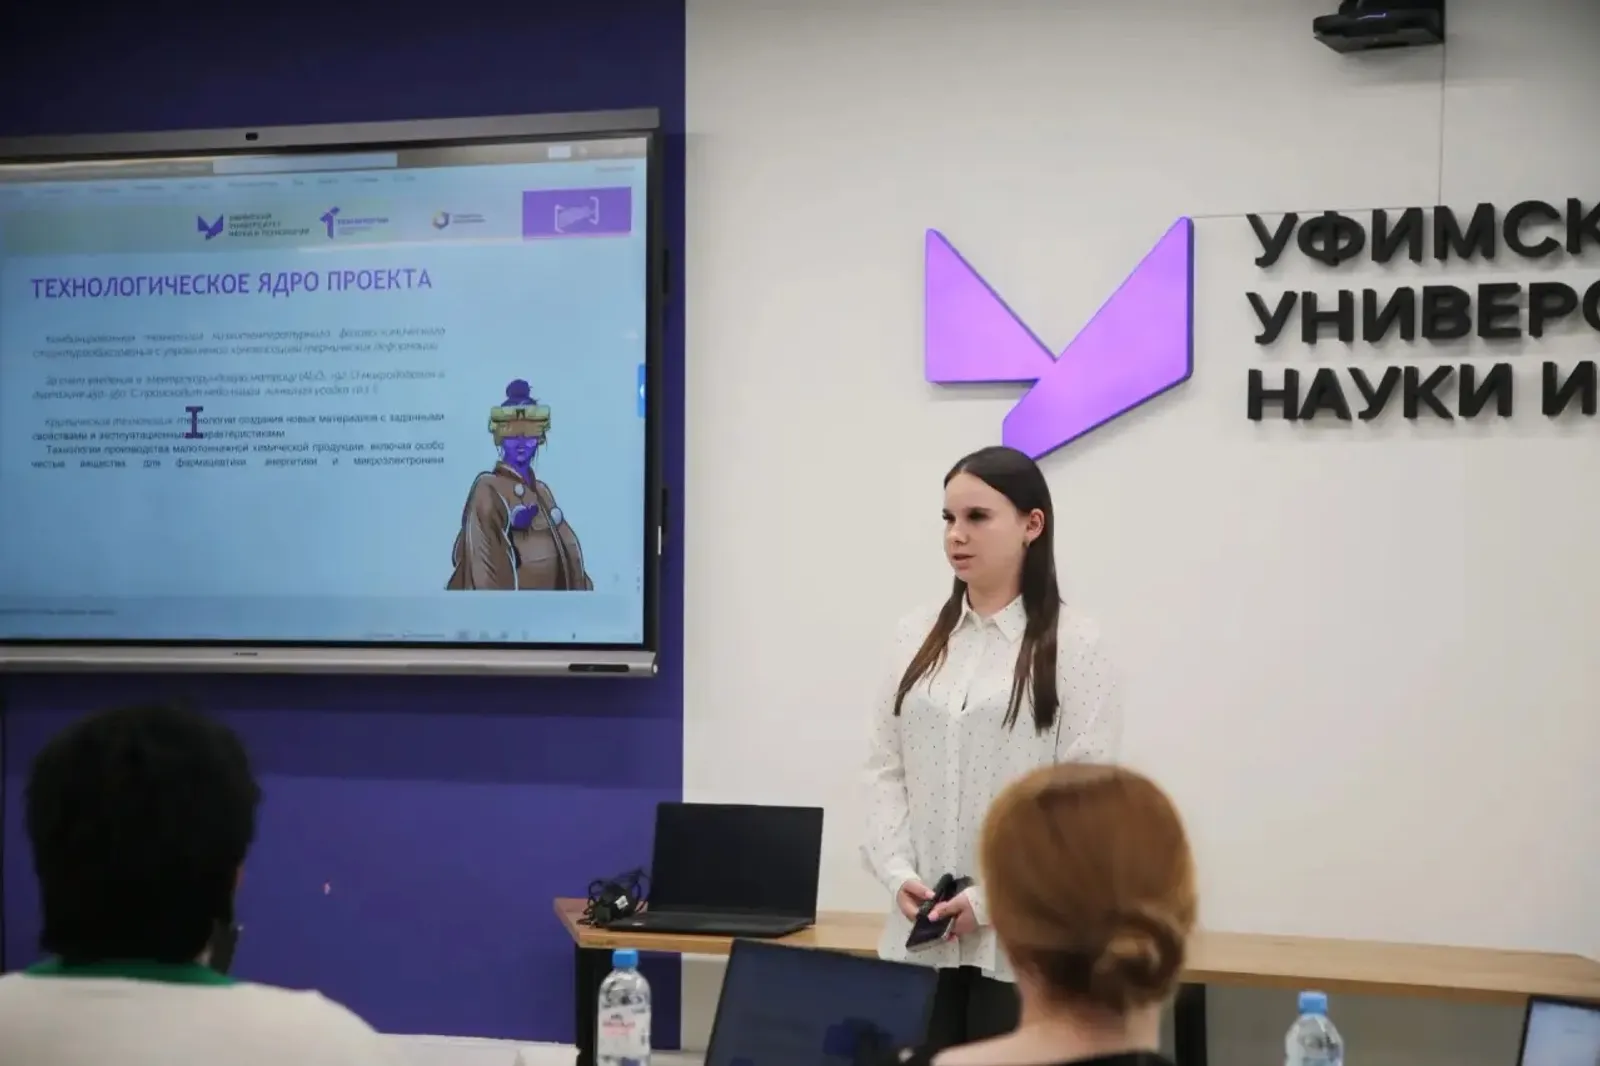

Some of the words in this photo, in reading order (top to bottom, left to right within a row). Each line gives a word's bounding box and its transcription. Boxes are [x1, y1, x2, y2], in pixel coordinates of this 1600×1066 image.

[1246, 198, 1600, 267] УФИМСК
[31, 272, 250, 299] ТЕХНОЛОГИЧЕСКОЕ
[258, 271, 320, 298] ЯДРО
[327, 267, 433, 291] ПРОЕКТА
[1247, 363, 1513, 421] НАУКИ
[1541, 360, 1598, 418] И
